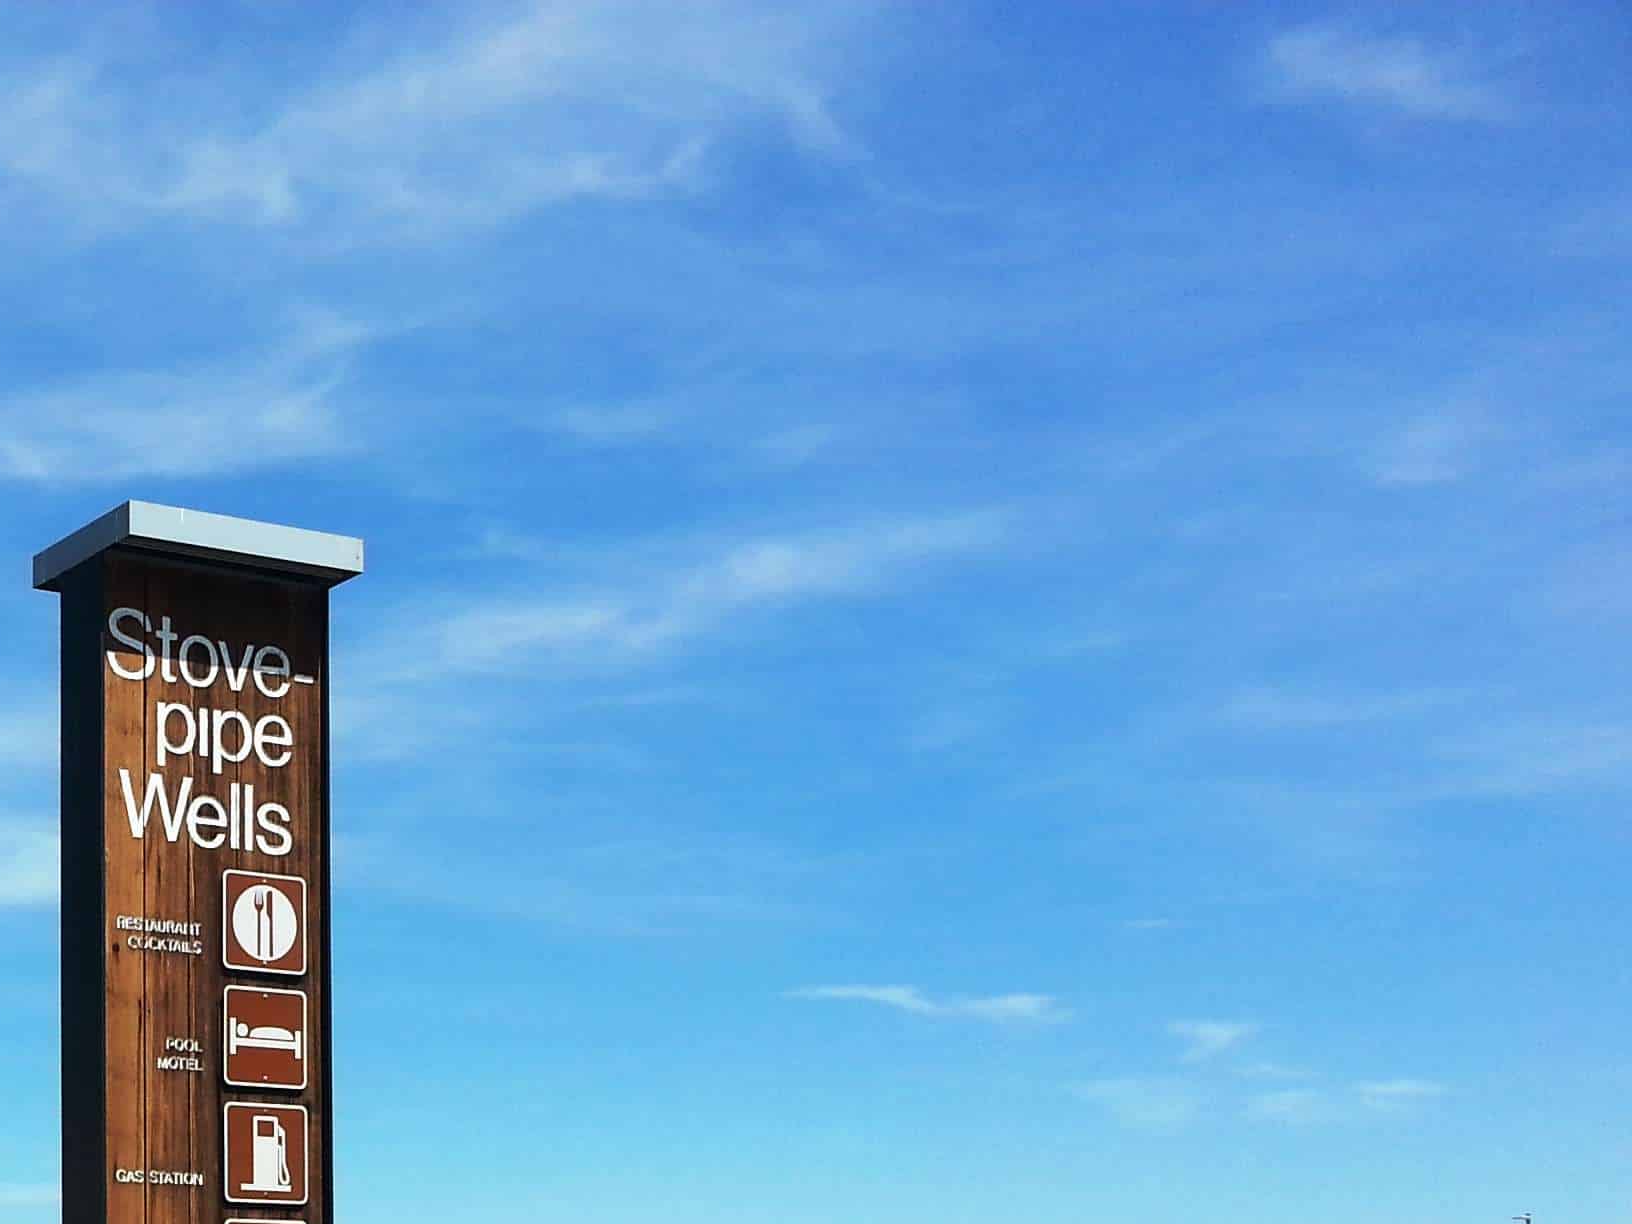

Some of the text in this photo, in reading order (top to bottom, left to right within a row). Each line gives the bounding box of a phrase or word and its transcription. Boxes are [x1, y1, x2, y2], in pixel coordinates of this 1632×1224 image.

[106, 608, 314, 697] Stove-
[156, 702, 294, 774] pipe
[119, 769, 293, 856] Wells
[117, 916, 201, 936] RESTAURANT
[127, 934, 202, 955] COCKTAILS
[166, 1038, 203, 1053] POOL
[157, 1056, 204, 1072] MOTEL
[116, 1169, 204, 1186] GAS STATION
